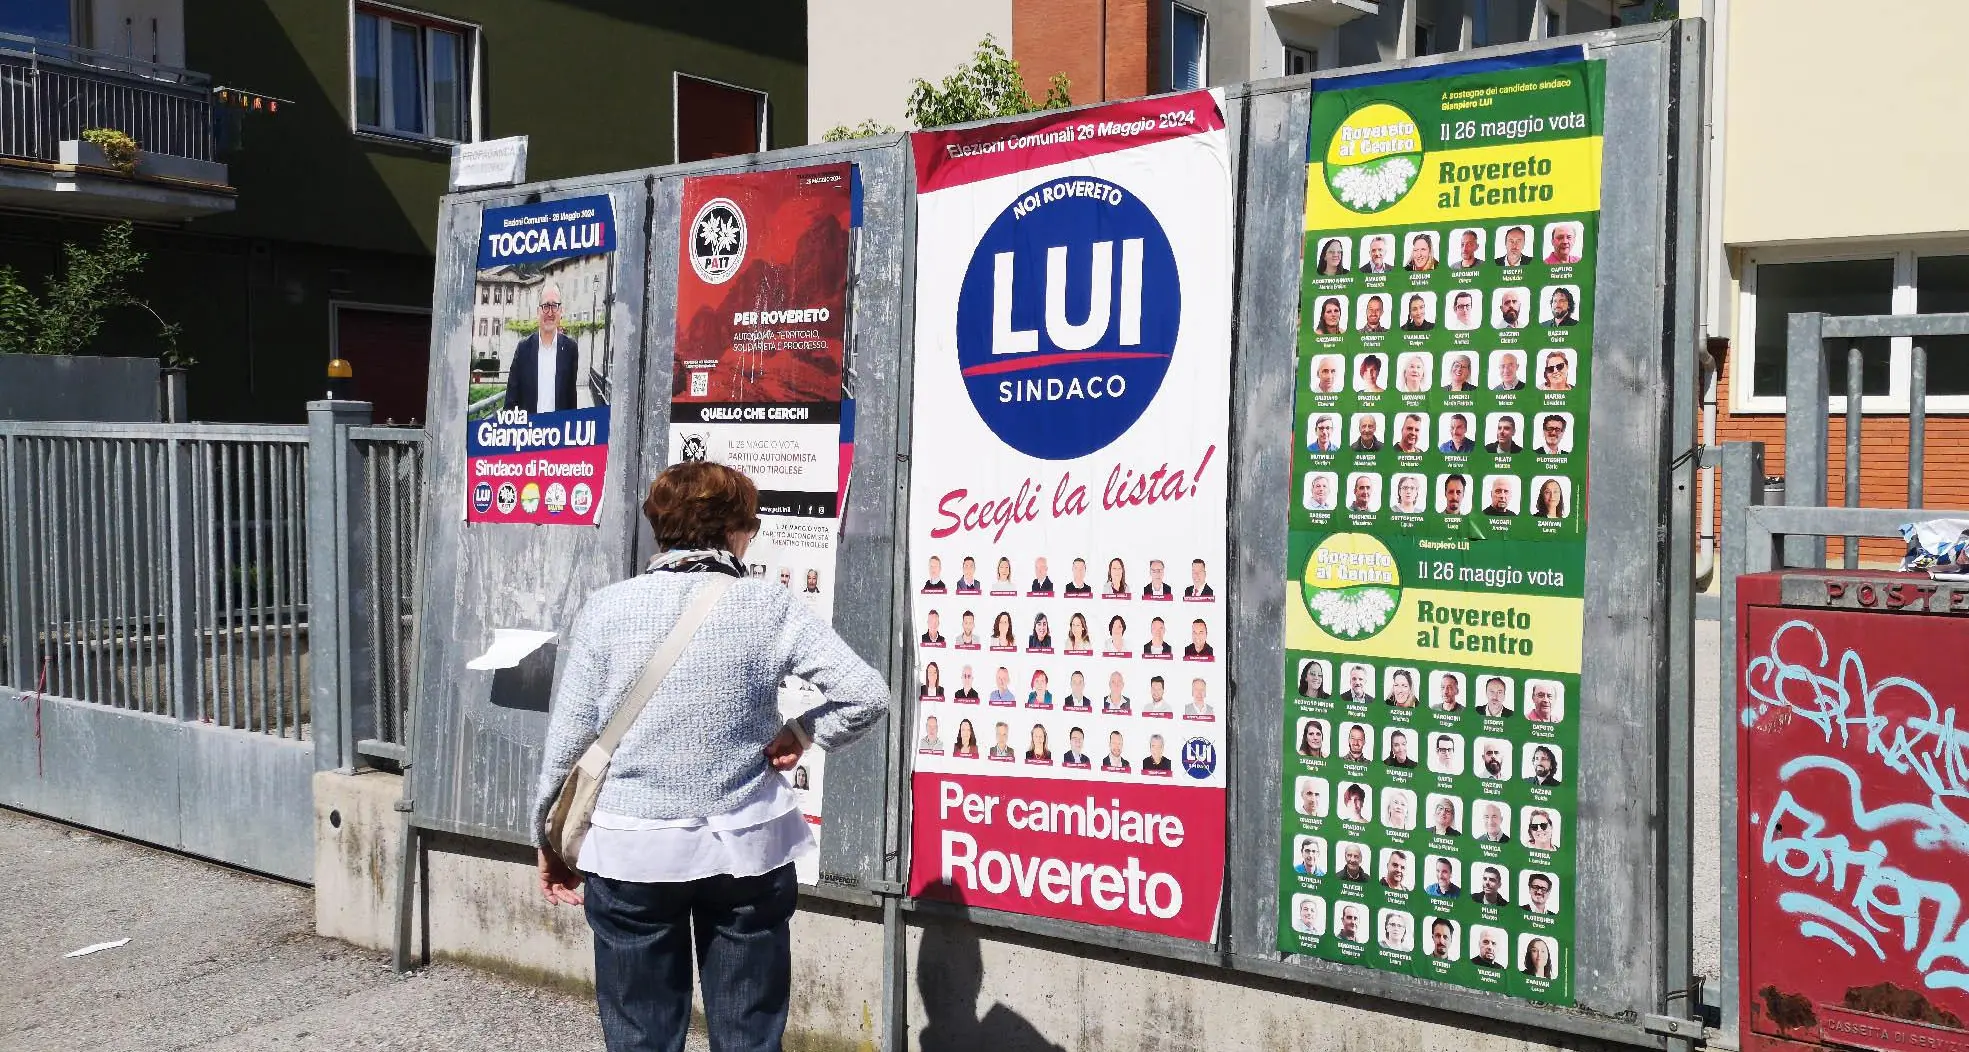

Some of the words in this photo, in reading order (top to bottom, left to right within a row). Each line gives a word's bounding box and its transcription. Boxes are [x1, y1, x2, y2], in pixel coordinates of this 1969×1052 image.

[1441, 91, 1447, 101] A
[1449, 87, 1485, 101] sostegno
[1485, 85, 1498, 96] del
[1499, 81, 1538, 95] candidato
[1539, 78, 1572, 90] sindaco
[1441, 100, 1478, 112] Gianpiero
[1479, 98, 1493, 108] LUI
[946, 137, 1005, 159] Elezioni
[1007, 125, 1075, 151] Comunali
[1076, 124, 1095, 140] 26
[1097, 116, 1156, 139] Maggio
[1158, 109, 1196, 129] 2024
[1341, 123, 1415, 141] Rovereto
[1440, 123, 1450, 141] Il
[1455, 120, 1476, 140] 26
[1480, 114, 1544, 139] maggio
[1550, 111, 1586, 130] vota
[1339, 139, 1355, 157] al
[1359, 136, 1415, 155] Centro
[1438, 155, 1552, 184] Rovereto
[1013, 195, 1041, 220] NOI
[1043, 179, 1123, 206] ROVERETO
[1438, 185, 1461, 209] al
[1469, 180, 1554, 206] Centro
[524, 214, 549, 225] Comunali
[561, 210, 581, 222] Maggio
[489, 228, 551, 258] TOCCA
[552, 227, 567, 250] A
[704, 256, 730, 269] PATT
[991, 237, 1145, 355] LUI
[734, 311, 758, 327] PER
[760, 307, 830, 326] ROVERETO
[999, 374, 1126, 403] SINDACO
[496, 405, 528, 425] vota
[700, 407, 743, 422] QUELLO
[744, 407, 765, 420] CHE
[767, 407, 809, 420] CERCHI
[478, 421, 561, 452] Gianpiero
[564, 420, 596, 446] LUI
[778, 440, 800, 450] VOTA
[475, 459, 523, 477] Sindaco
[525, 459, 537, 477] di
[538, 459, 594, 477] Rovereto
[727, 452, 759, 462] PARTITO
[760, 453, 817, 463] AUTONOMISTA
[767, 465, 804, 475] TIROLESE
[930, 477, 1042, 544] Scegli
[1052, 470, 1090, 518] la
[1102, 444, 1216, 511] lista!
[1418, 539, 1456, 551] Gianpiero
[1456, 541, 1470, 551] LUI
[1316, 548, 1392, 567] Rovereto
[1316, 565, 1332, 580] al
[1337, 567, 1393, 584] Centro
[1418, 561, 1429, 579] Il
[1433, 562, 1454, 580] 26
[1459, 563, 1523, 588] maggio
[1526, 570, 1564, 587] vota
[1824, 579, 1969, 613] POSTE
[1417, 600, 1531, 630] Rovereto
[1416, 626, 1440, 649] al
[1449, 627, 1534, 656] Centro
[1186, 743, 1212, 763] LUI
[940, 780, 1000, 825] Per
[1006, 796, 1185, 848] cambiare
[941, 829, 1183, 920] Rovereto
[1827, 1018, 1889, 1040] CASSETTA
